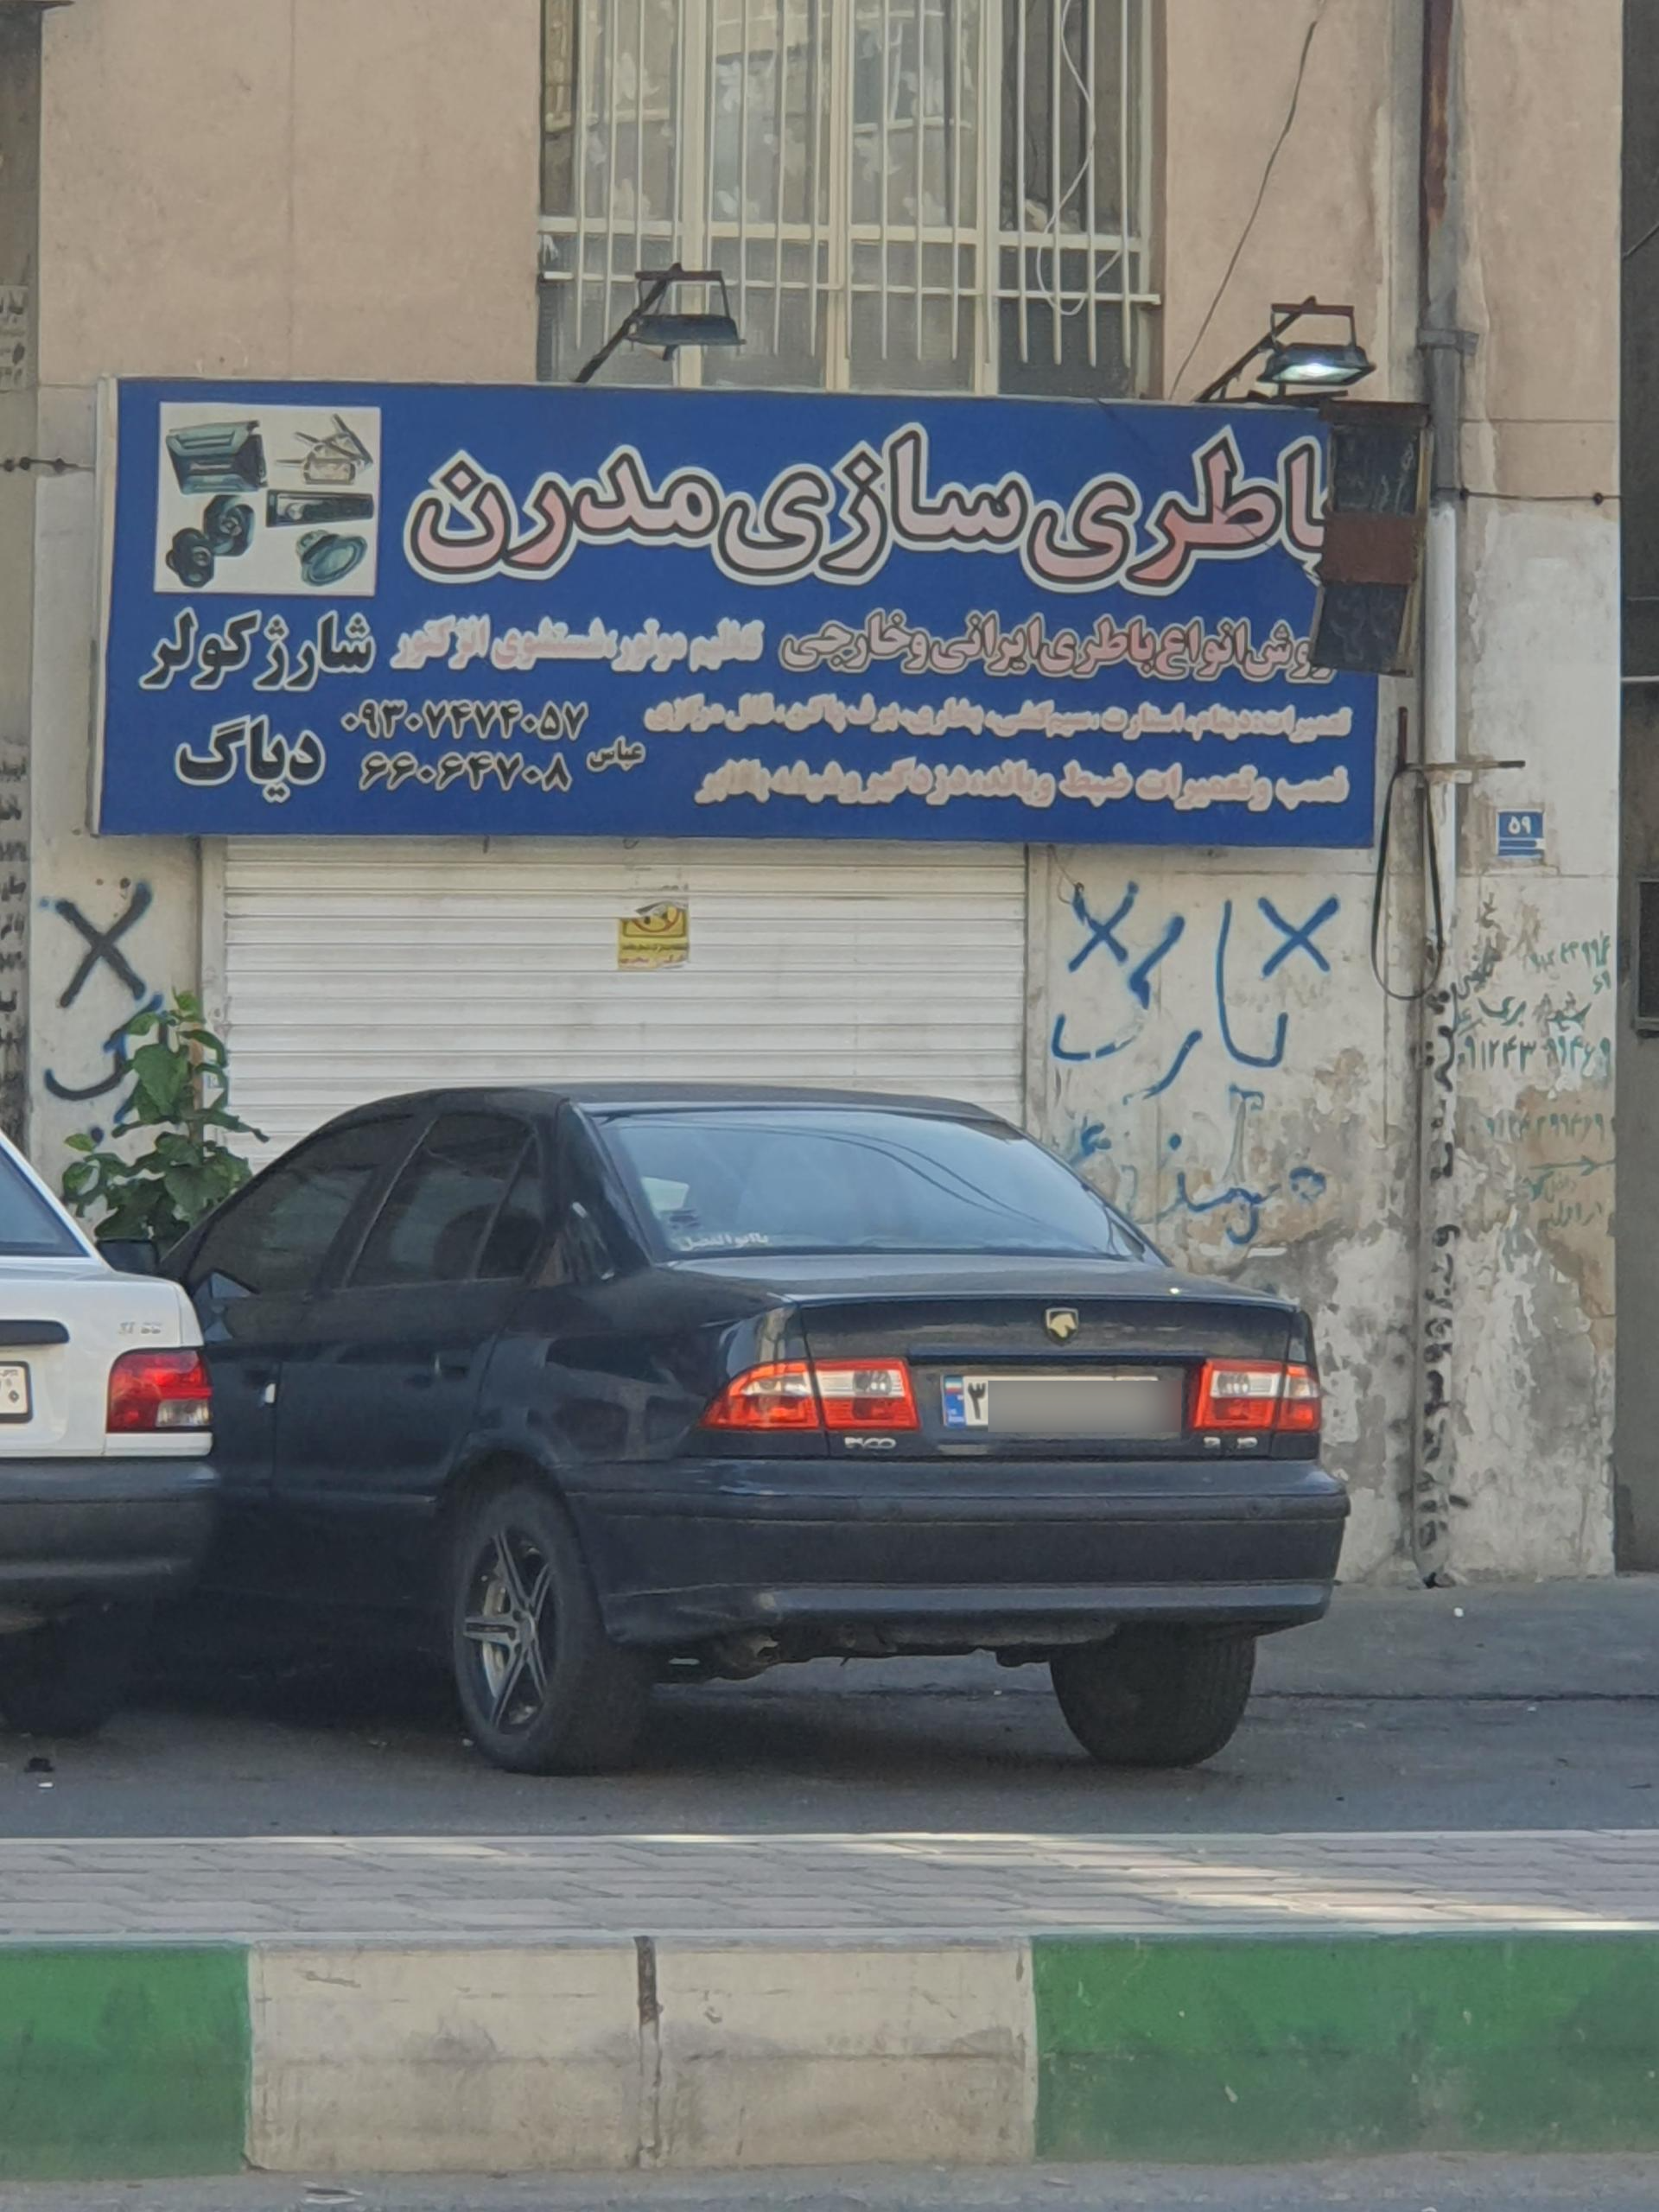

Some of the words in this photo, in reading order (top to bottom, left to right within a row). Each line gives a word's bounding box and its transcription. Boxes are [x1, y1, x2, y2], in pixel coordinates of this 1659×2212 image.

[404, 446, 720, 582] مدرن
[712, 423, 1039, 586] سازی
[1020, 424, 1325, 595] اطری
[139, 607, 262, 690] کولر
[253, 610, 376, 691] شارژ
[930, 610, 1046, 677] ایرانی
[1037, 612, 1156, 678] باطری
[1154, 614, 1251, 681] انواع
[340, 698, 589, 741] ۰۹۳۰۷۴۷۴۰۵۷
[175, 714, 326, 803] دیاگ
[358, 750, 573, 792] ۶۶۰۶۴۷۰۸
[586, 735, 646, 772] عباس
[1508, 815, 1532, 835] ۵۹
